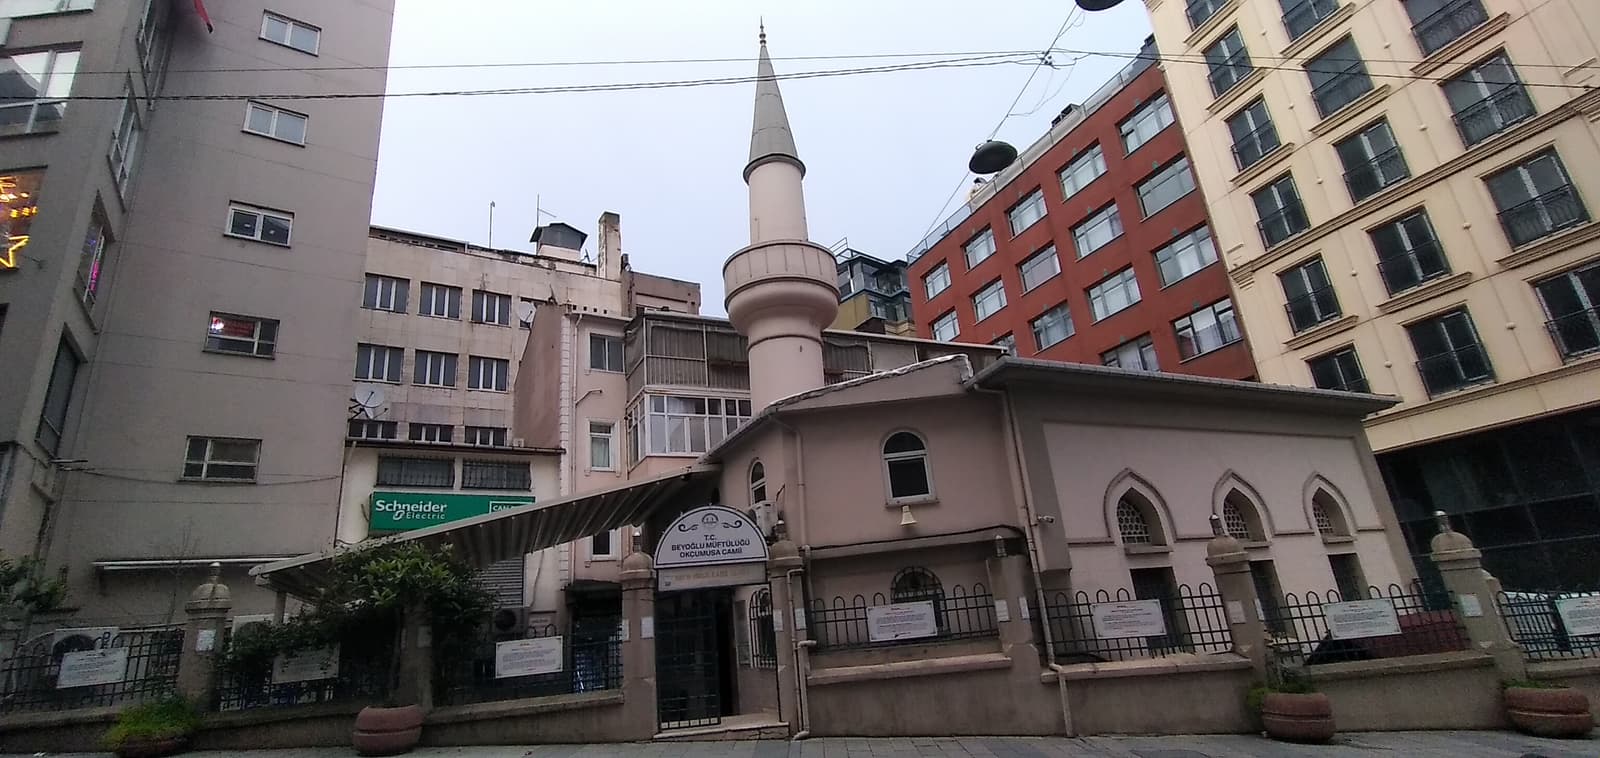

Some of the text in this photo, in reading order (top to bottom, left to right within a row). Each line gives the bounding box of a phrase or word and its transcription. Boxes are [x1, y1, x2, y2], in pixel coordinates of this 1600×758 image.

[375, 500, 447, 512] Schneider
[406, 512, 445, 520] Electric
[671, 539, 750, 551] BEYOĞLU MÜFTÜLÜĞÜ
